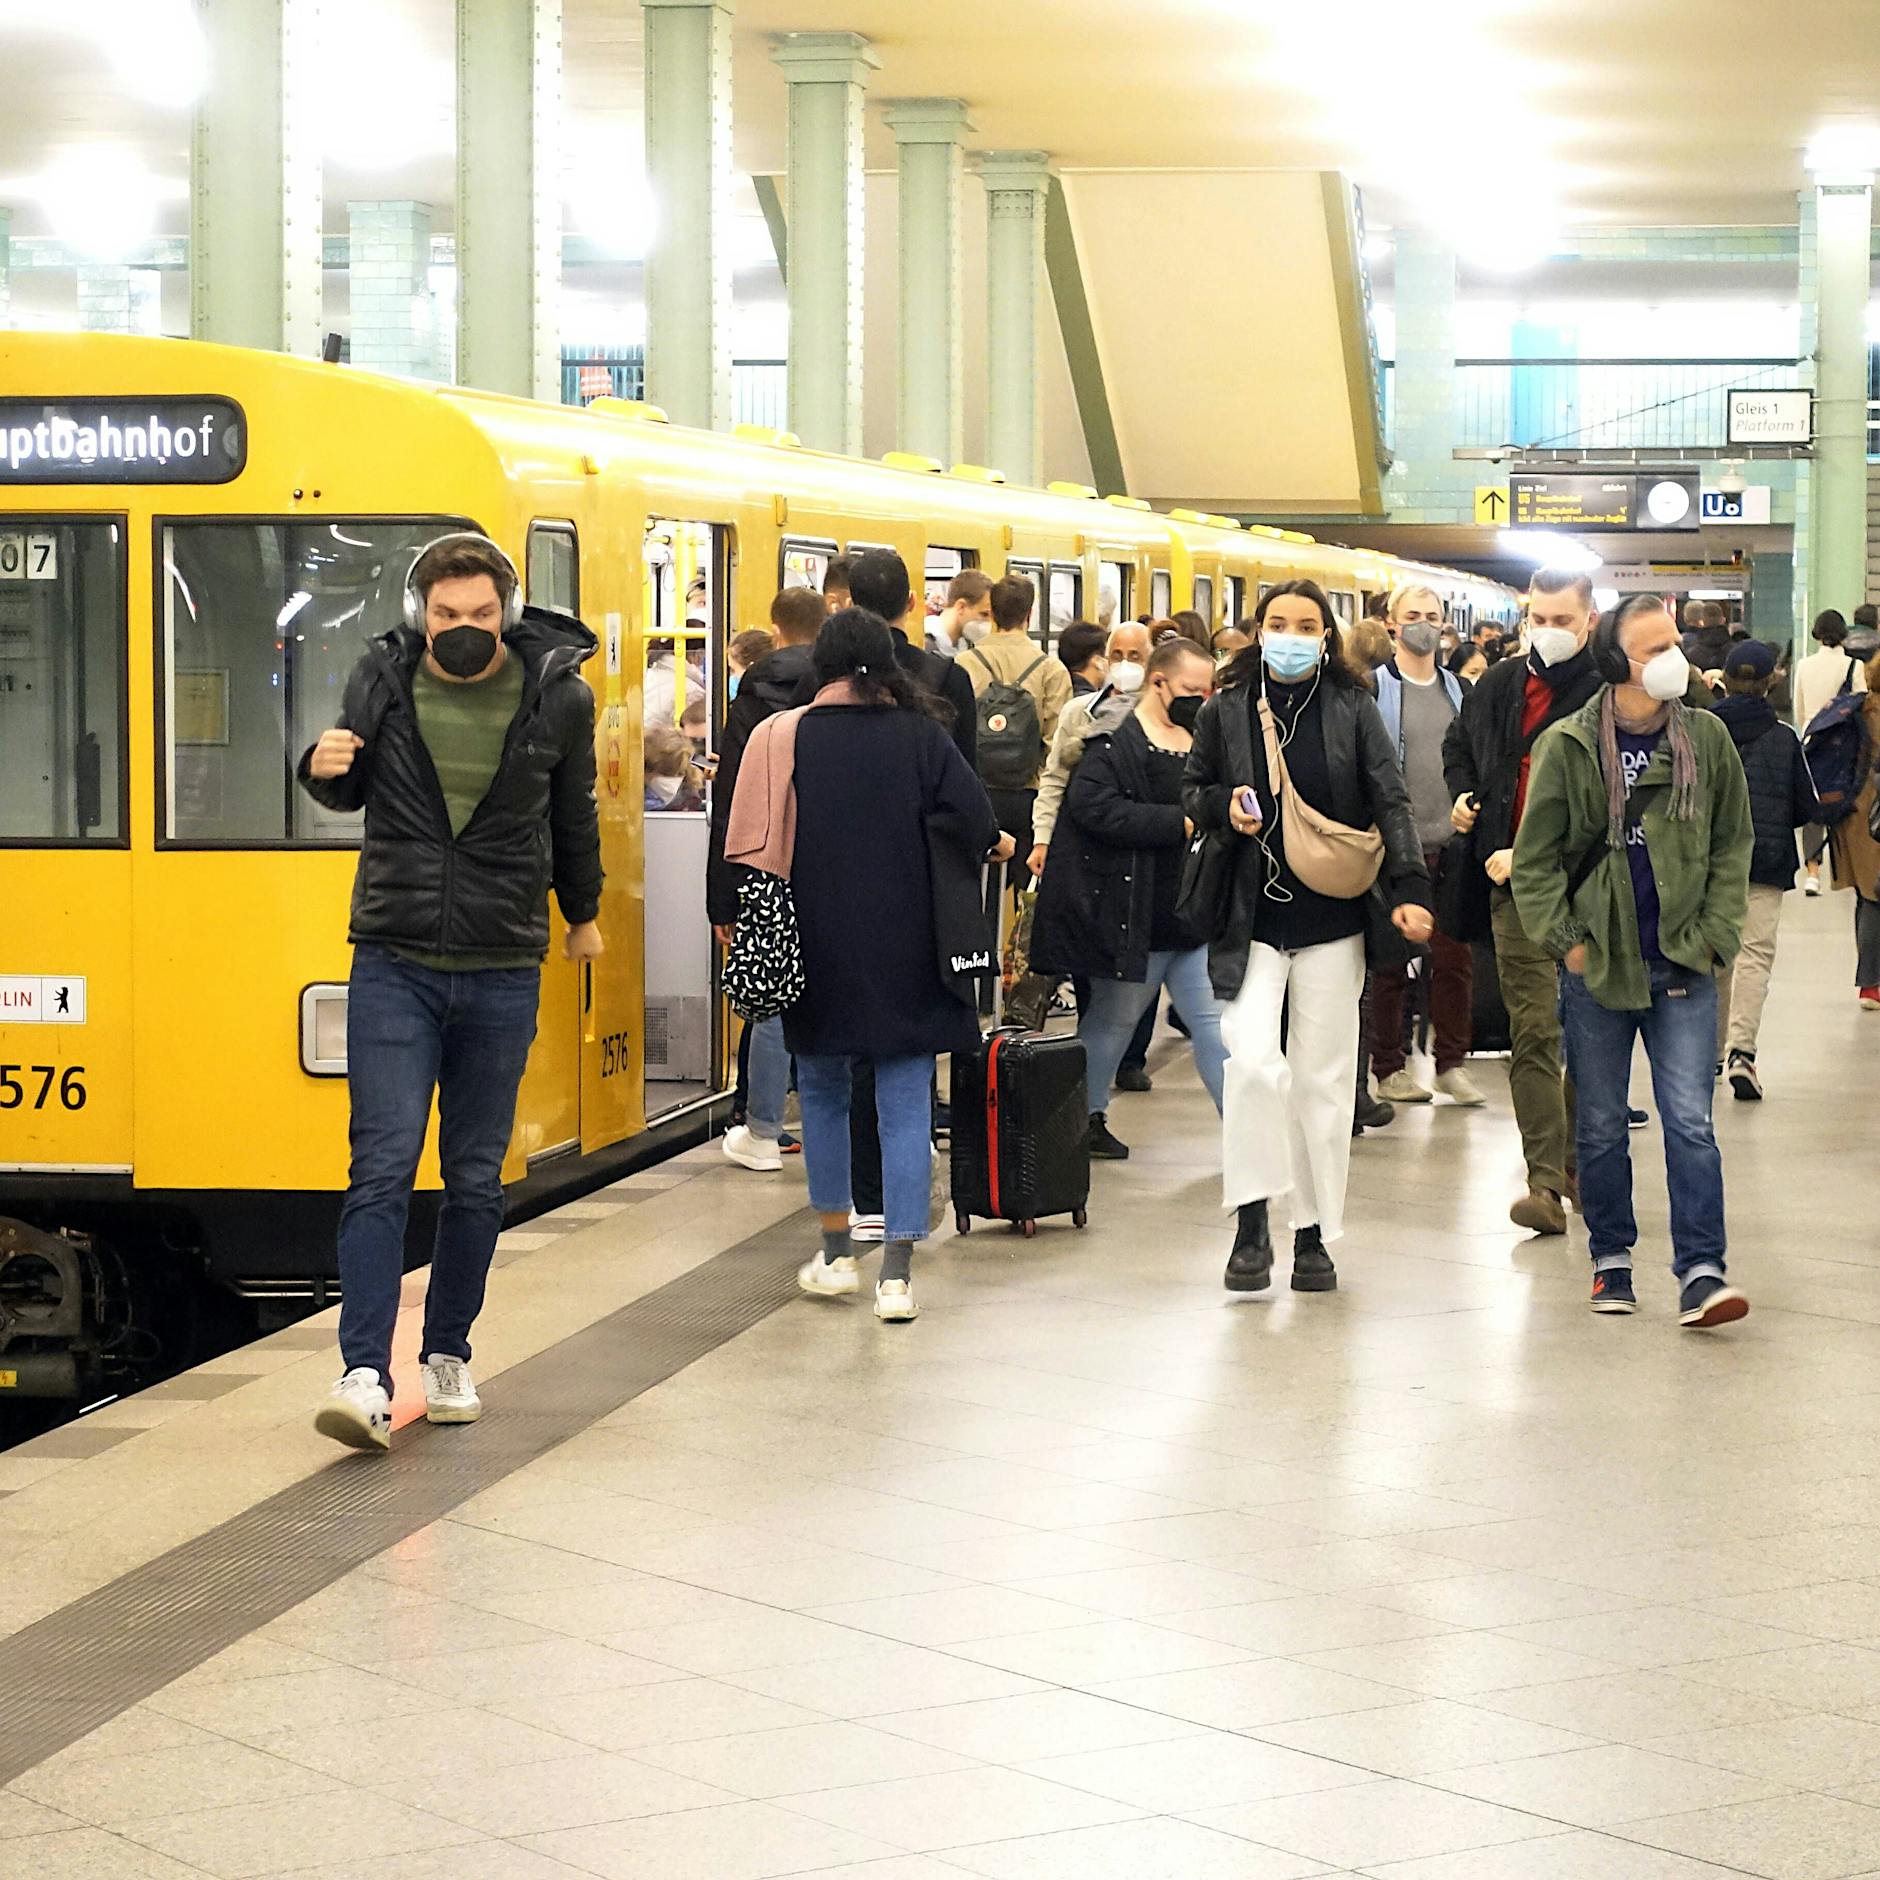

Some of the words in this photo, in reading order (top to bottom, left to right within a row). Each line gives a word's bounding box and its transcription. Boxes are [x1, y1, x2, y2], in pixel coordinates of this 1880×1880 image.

[1736, 402, 1768, 415] Gleis
[1773, 403, 1779, 415] 1
[1736, 419, 1794, 432] Platform
[1800, 419, 1806, 431] 1
[1621, 750, 1653, 769] DA
[951, 951, 990, 972] Vinted
[0, 991, 32, 1007] LIN
[602, 1031, 628, 1078] 2576
[0, 1064, 87, 1111] 576
